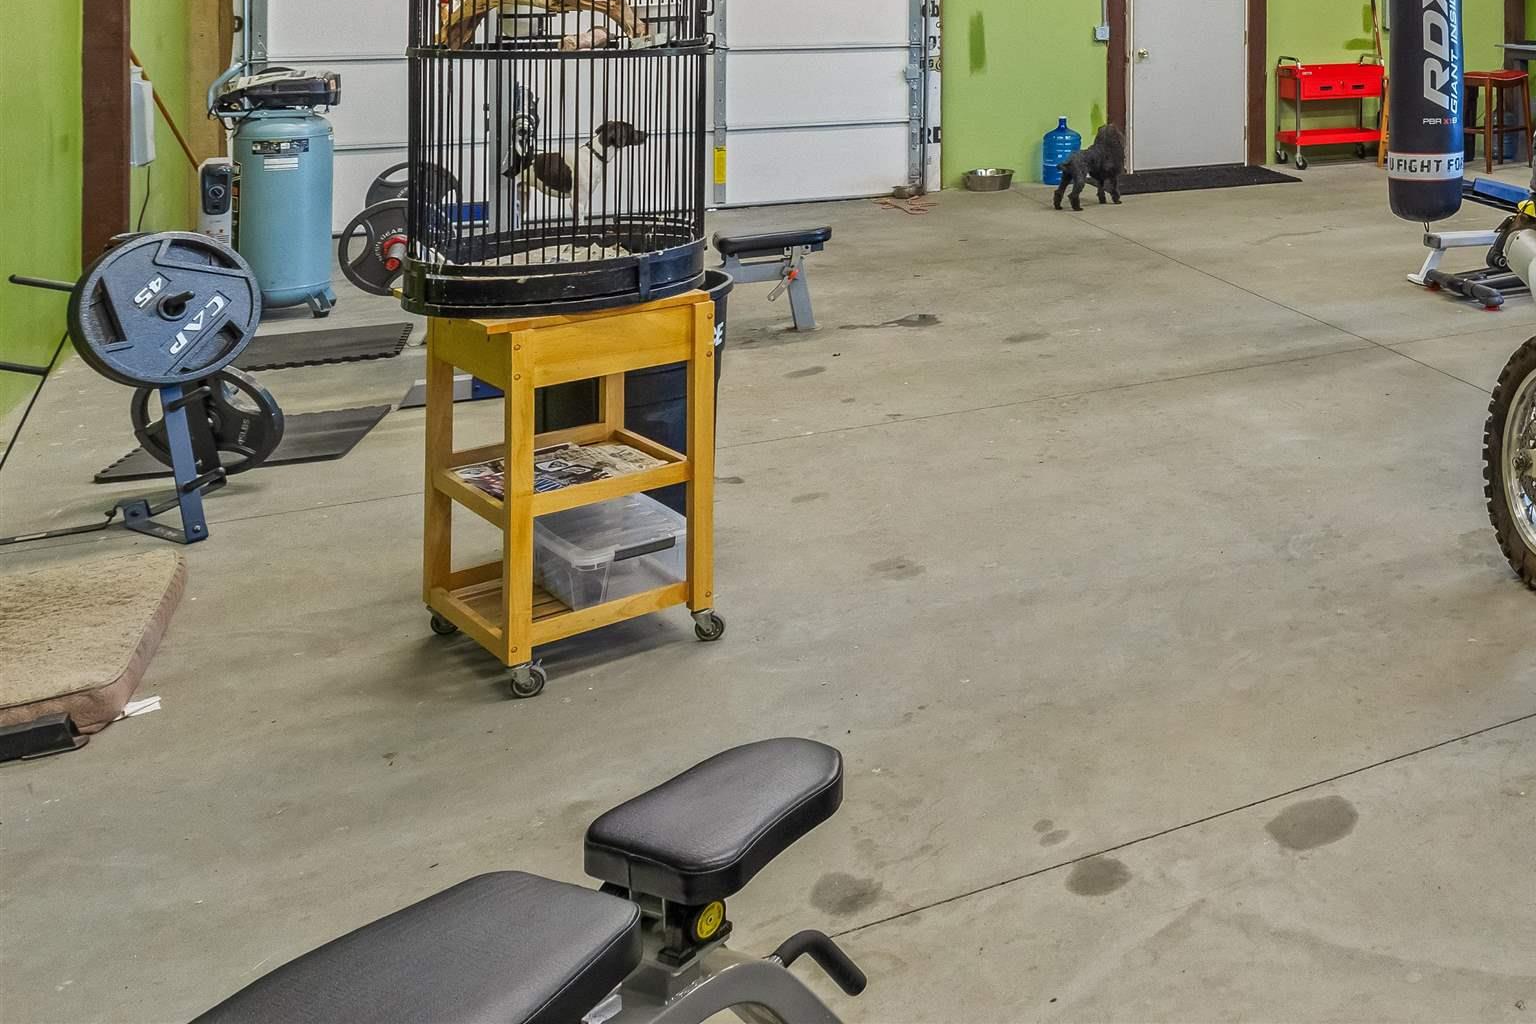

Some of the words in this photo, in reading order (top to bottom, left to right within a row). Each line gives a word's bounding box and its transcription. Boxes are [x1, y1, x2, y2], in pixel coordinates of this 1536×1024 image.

[1450, 49, 1458, 113] GIANT
[1396, 158, 1442, 173] FIGHT
[134, 276, 162, 308] 45
[169, 295, 224, 355] CAP
